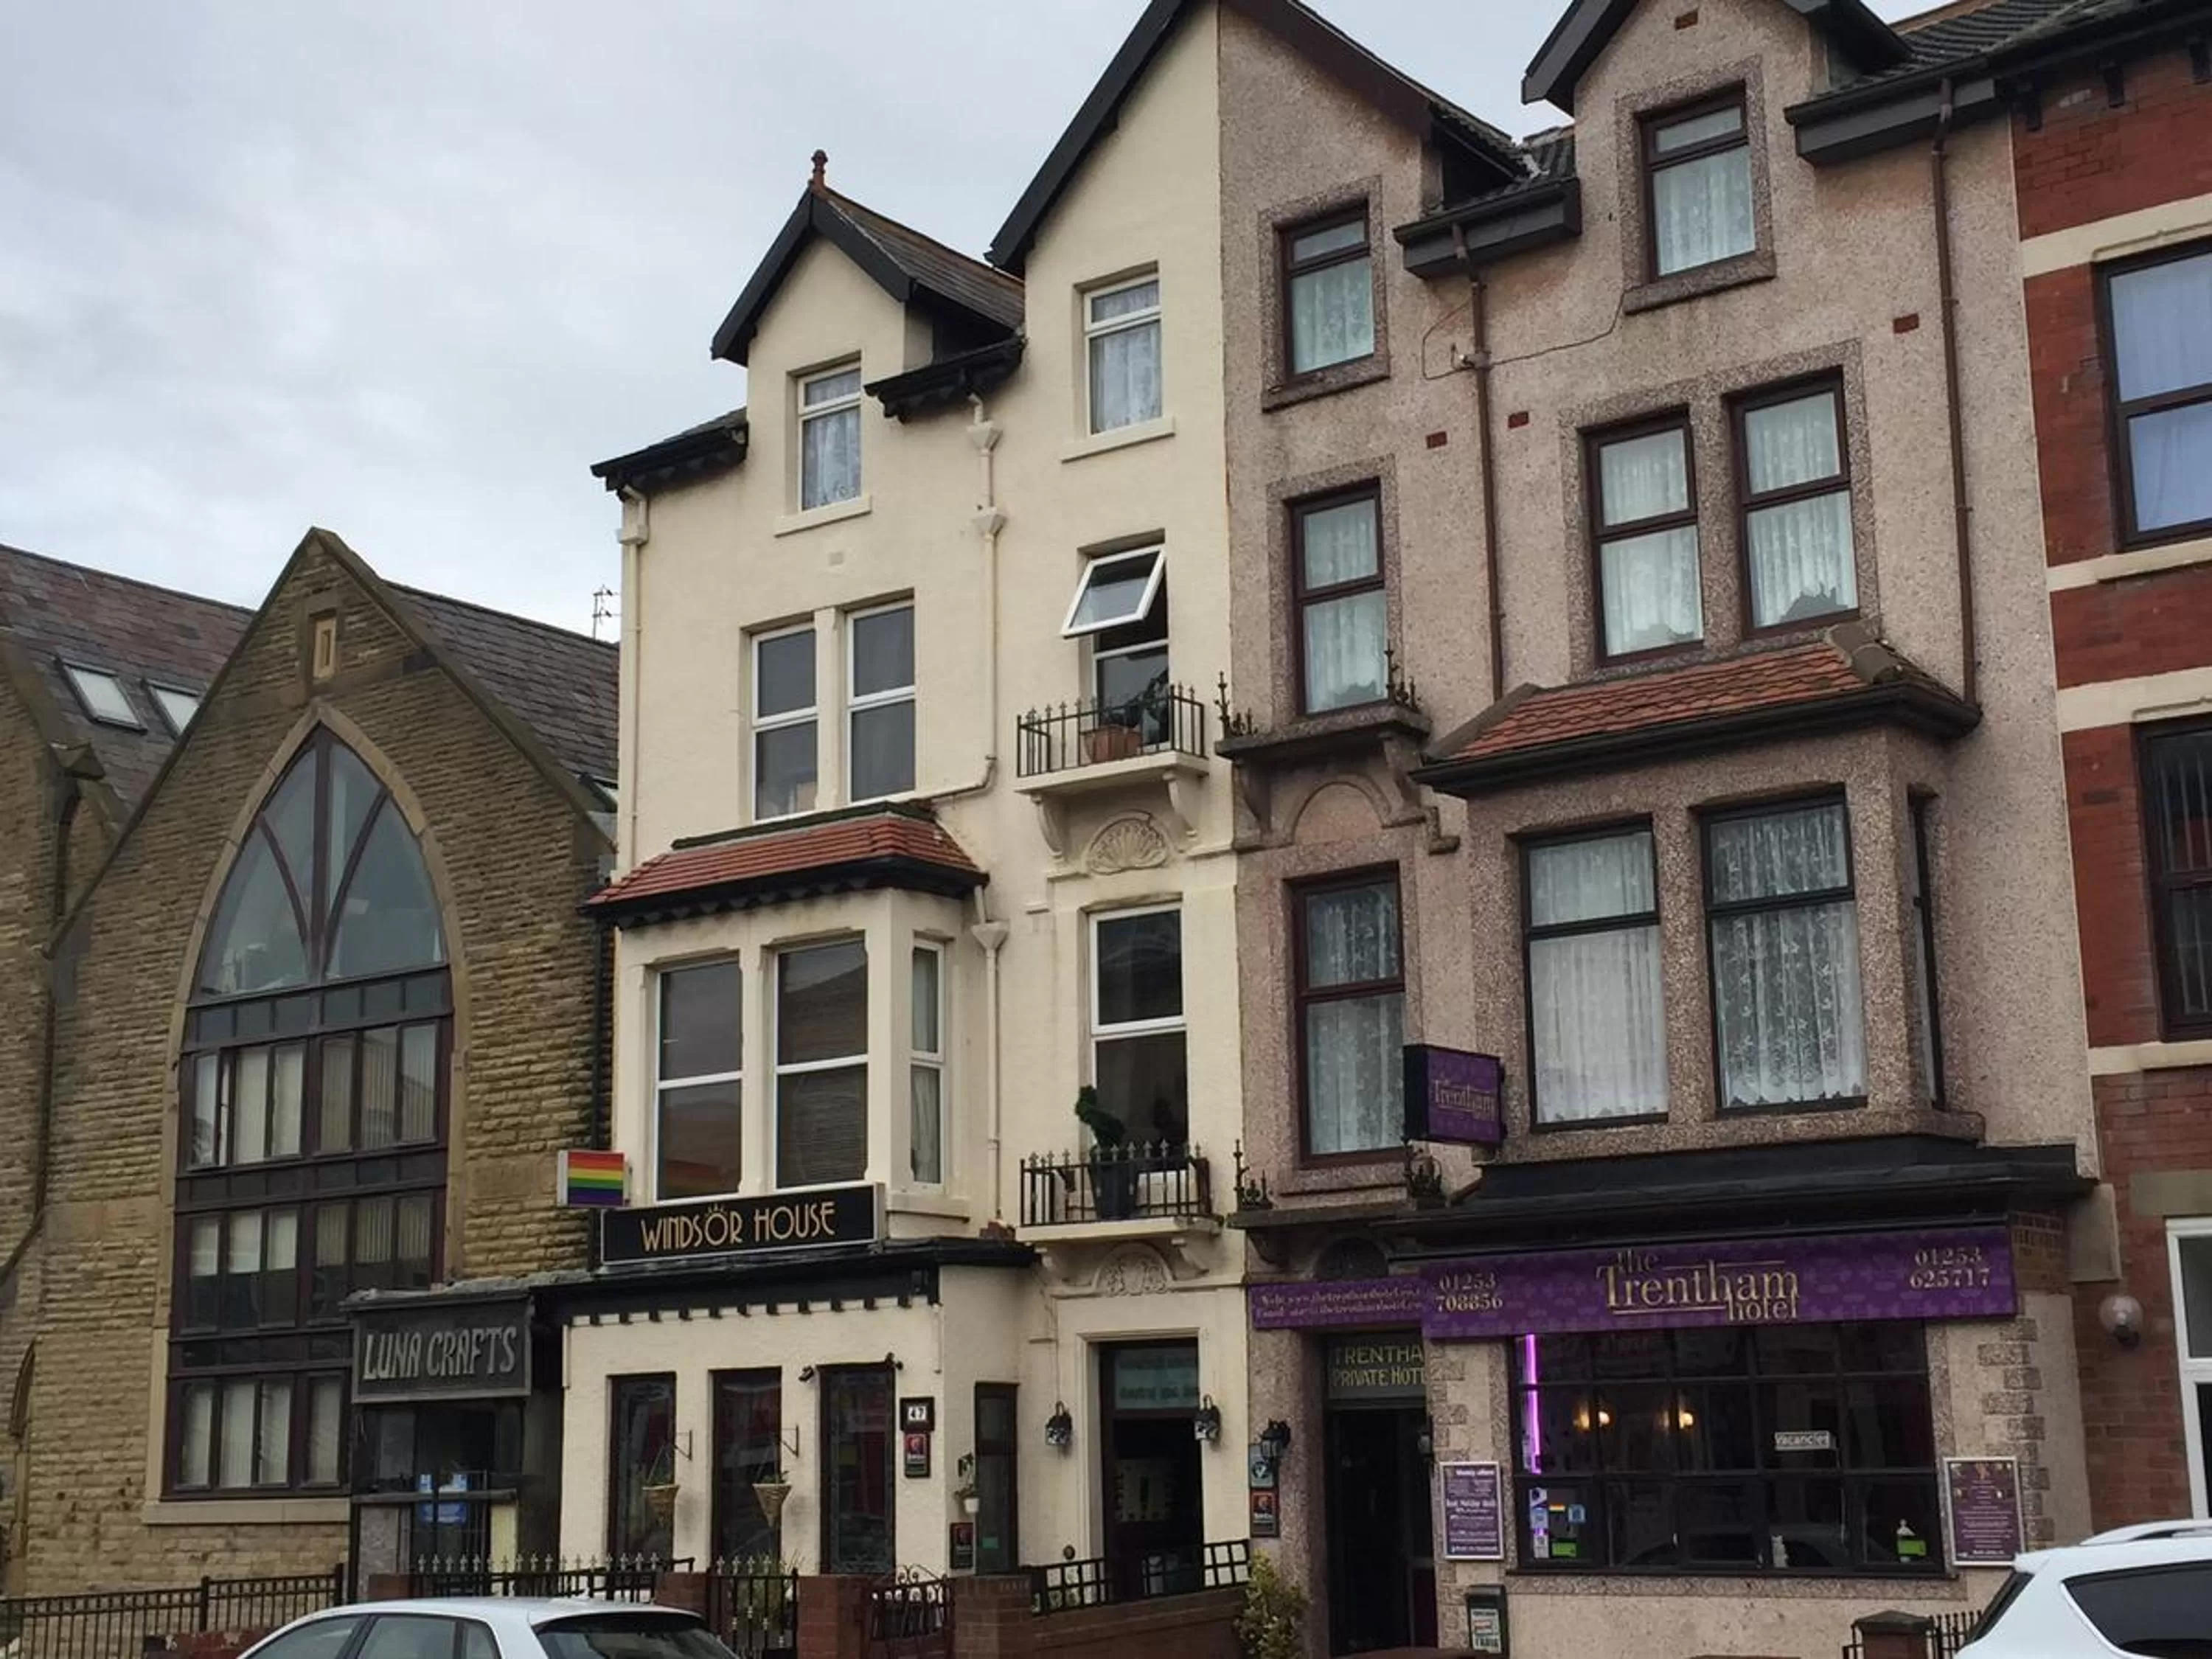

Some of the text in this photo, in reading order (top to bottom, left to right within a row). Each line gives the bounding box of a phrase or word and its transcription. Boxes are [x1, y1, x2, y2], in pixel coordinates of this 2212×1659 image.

[641, 1201, 835, 1251] WINDSOR HOUSE
[1617, 1249, 1658, 1273] The
[1595, 1259, 1800, 1307] Trentham
[1909, 1267, 1990, 1289] 625717
[1435, 1293, 1503, 1312] 708856
[1727, 1290, 1798, 1321] hotel
[364, 1327, 516, 1380] LUNA CRAFTS
[1331, 1368, 1389, 1386] PRIVATE
